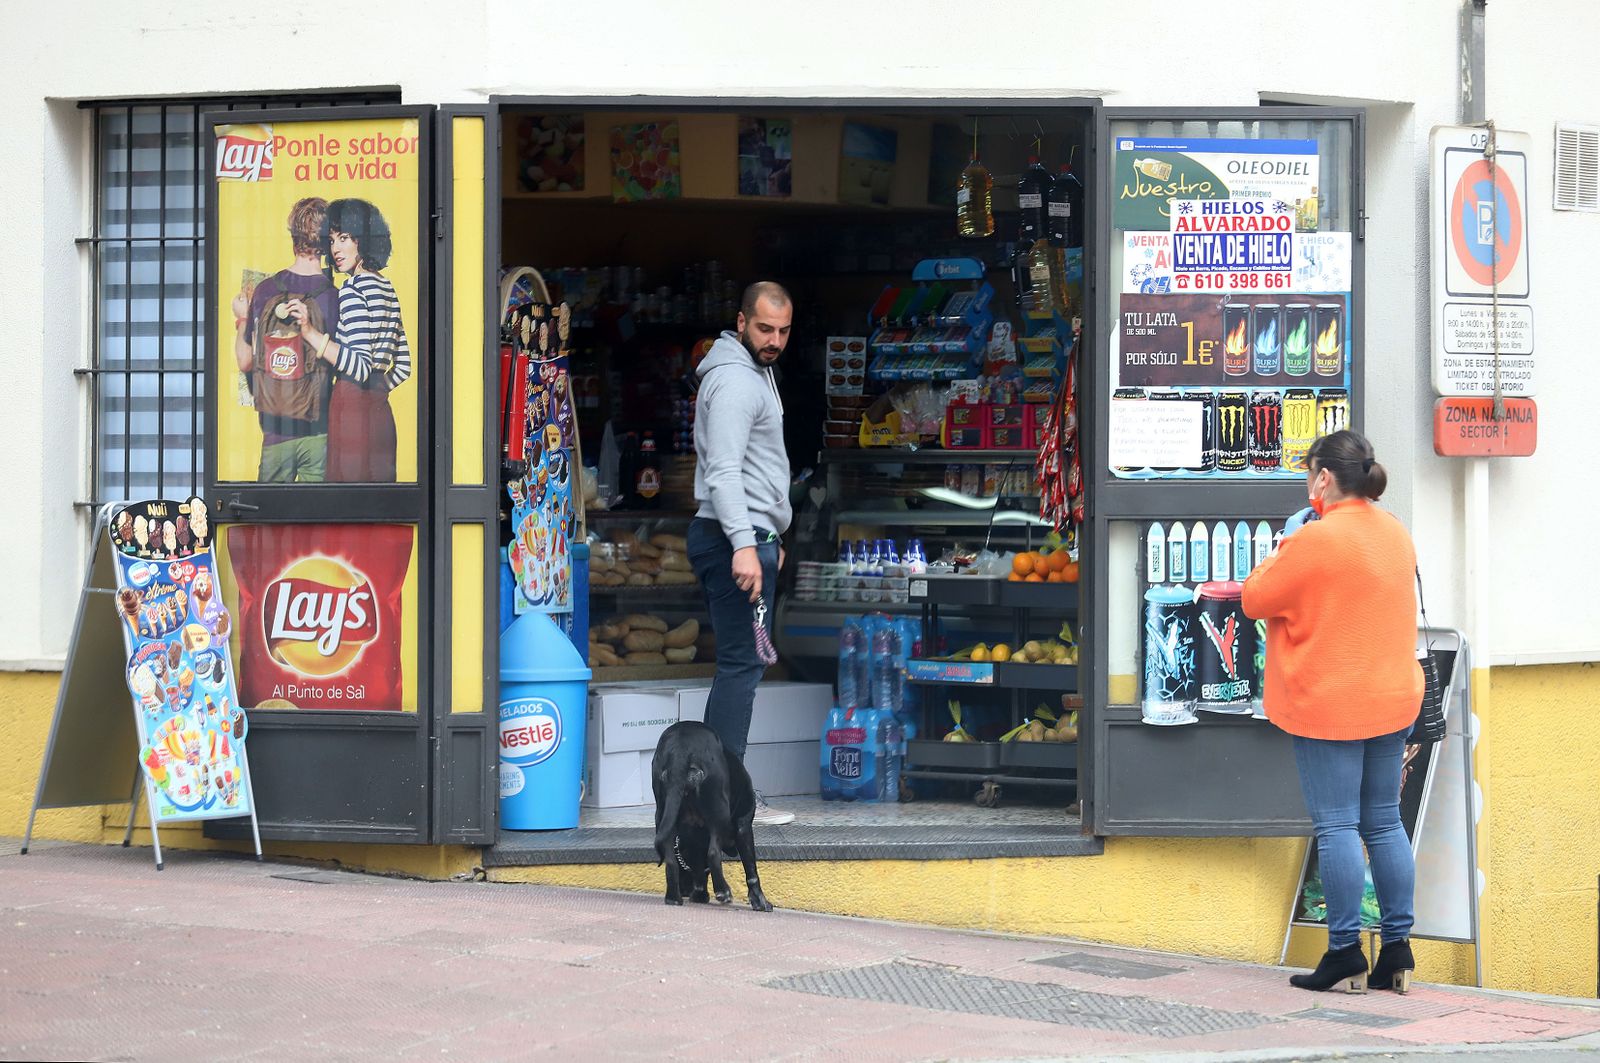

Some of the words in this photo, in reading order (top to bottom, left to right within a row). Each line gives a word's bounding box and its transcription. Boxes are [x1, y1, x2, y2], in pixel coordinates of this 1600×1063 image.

[273, 133, 341, 157] Ponle
[348, 132, 419, 155] sabor
[294, 163, 310, 182] a
[317, 158, 339, 181] la
[345, 156, 397, 180] vida
[1227, 160, 1310, 176] OLEODIEL
[1120, 168, 1212, 200] Nuestro
[1231, 189, 1252, 198] PRIMER
[1252, 190, 1272, 198] PREMIO
[1202, 201, 1264, 215] HIELOS
[1175, 215, 1291, 232] ALVARADO
[1133, 235, 1170, 247] VENTA
[1307, 236, 1335, 245] HIELO
[1175, 235, 1223, 265] VENTA
[1226, 235, 1246, 265] DE
[1248, 234, 1291, 265] HIELO
[1195, 273, 1224, 288] 610
[1229, 273, 1258, 288] 398
[1264, 273, 1292, 288] 661
[1125, 312, 1143, 326] TU
[1146, 312, 1178, 326] LATA
[1457, 340, 1483, 349] Domingos
[272, 353, 296, 370] Lay's
[1125, 352, 1148, 365] POR
[1150, 350, 1177, 365] SÓLO
[1444, 359, 1461, 367] ZONA
[1465, 359, 1473, 367] DE
[1447, 370, 1478, 379] LIMITADO
[1456, 382, 1478, 390] TICKET
[1482, 383, 1524, 391] OBLIATORIO
[1446, 406, 1477, 422] ZONA
[1482, 407, 1533, 423] NAANJA
[1460, 425, 1499, 438] SECTOR
[271, 582, 369, 656] Lay's
[272, 684, 284, 698] Al
[288, 685, 324, 699] Punto
[327, 685, 343, 699] de
[346, 684, 365, 699] Sal
[834, 749, 859, 763] Font
[834, 762, 859, 776] Vella
